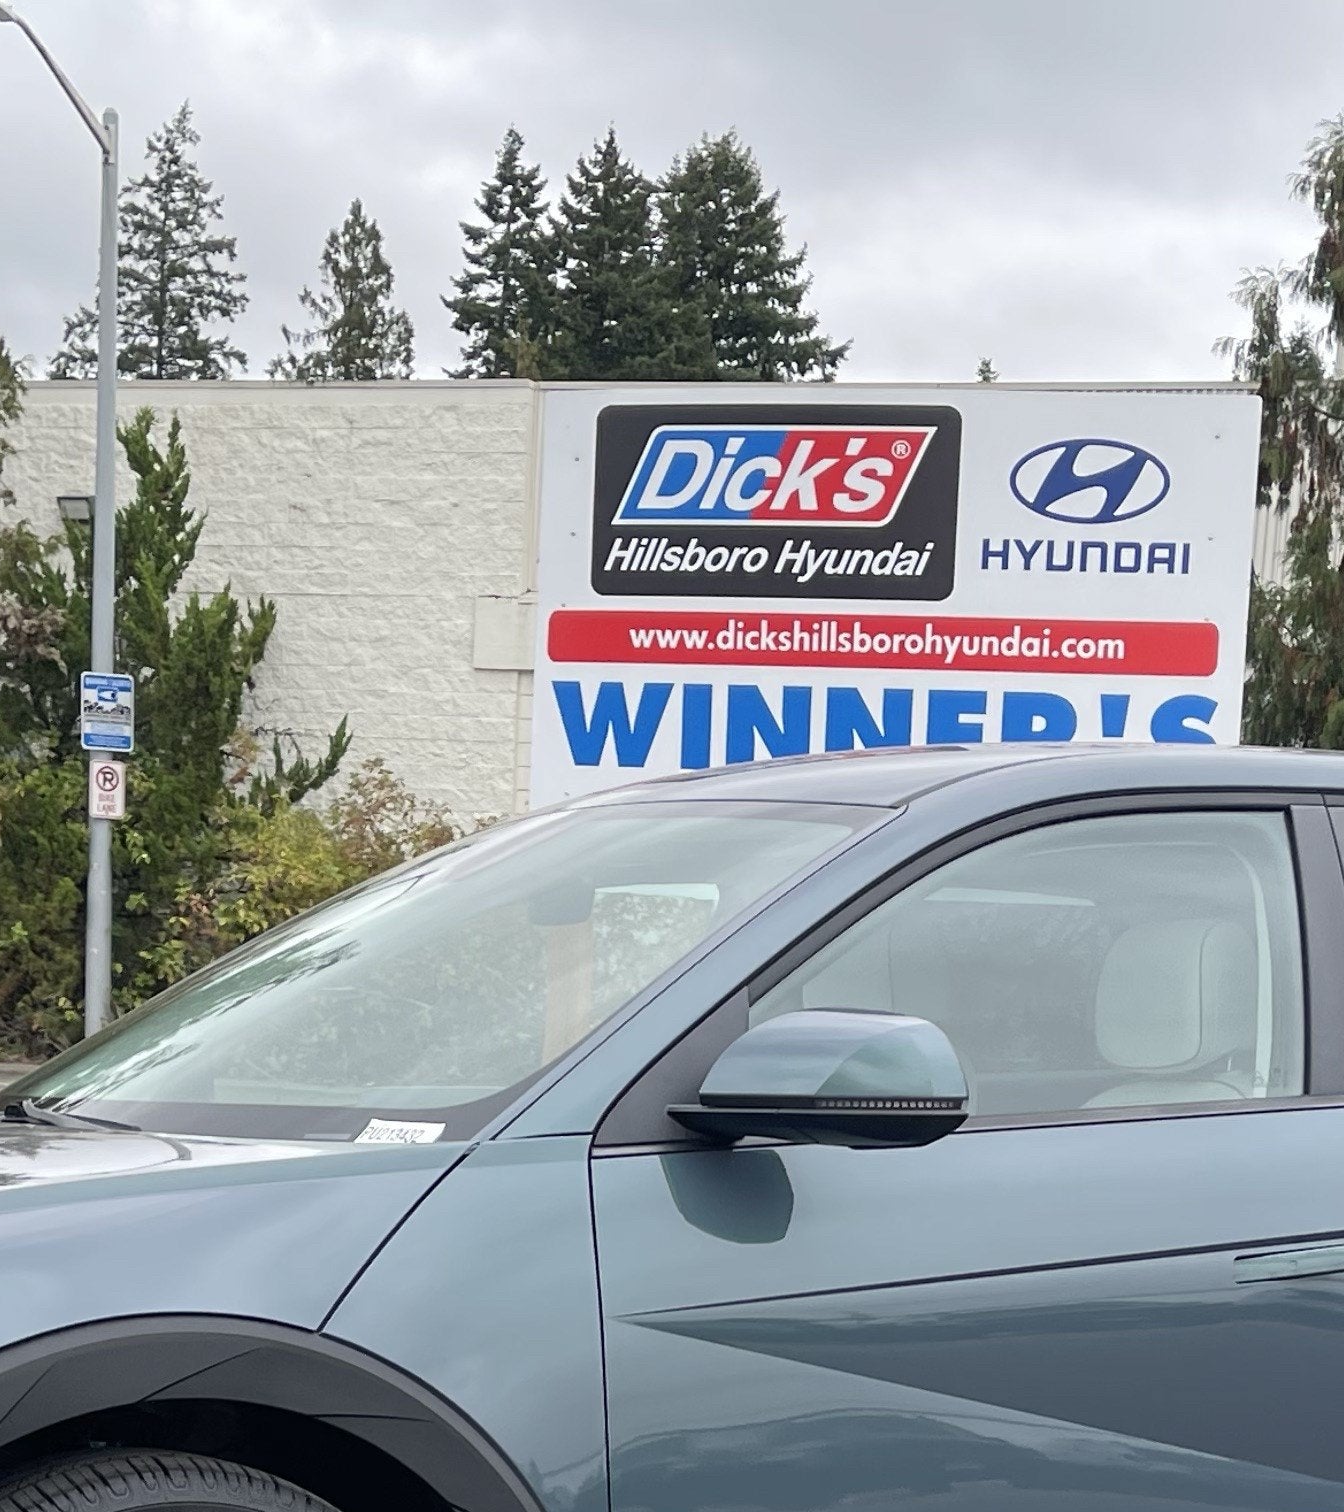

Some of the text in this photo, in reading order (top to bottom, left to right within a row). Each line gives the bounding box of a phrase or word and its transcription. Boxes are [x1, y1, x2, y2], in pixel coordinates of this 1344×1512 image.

[604, 537, 935, 583] Hillsboro Hyundai
[982, 538, 1191, 575] HYUNDAI
[629, 619, 1125, 665] www.dickshillsborohyundai.com
